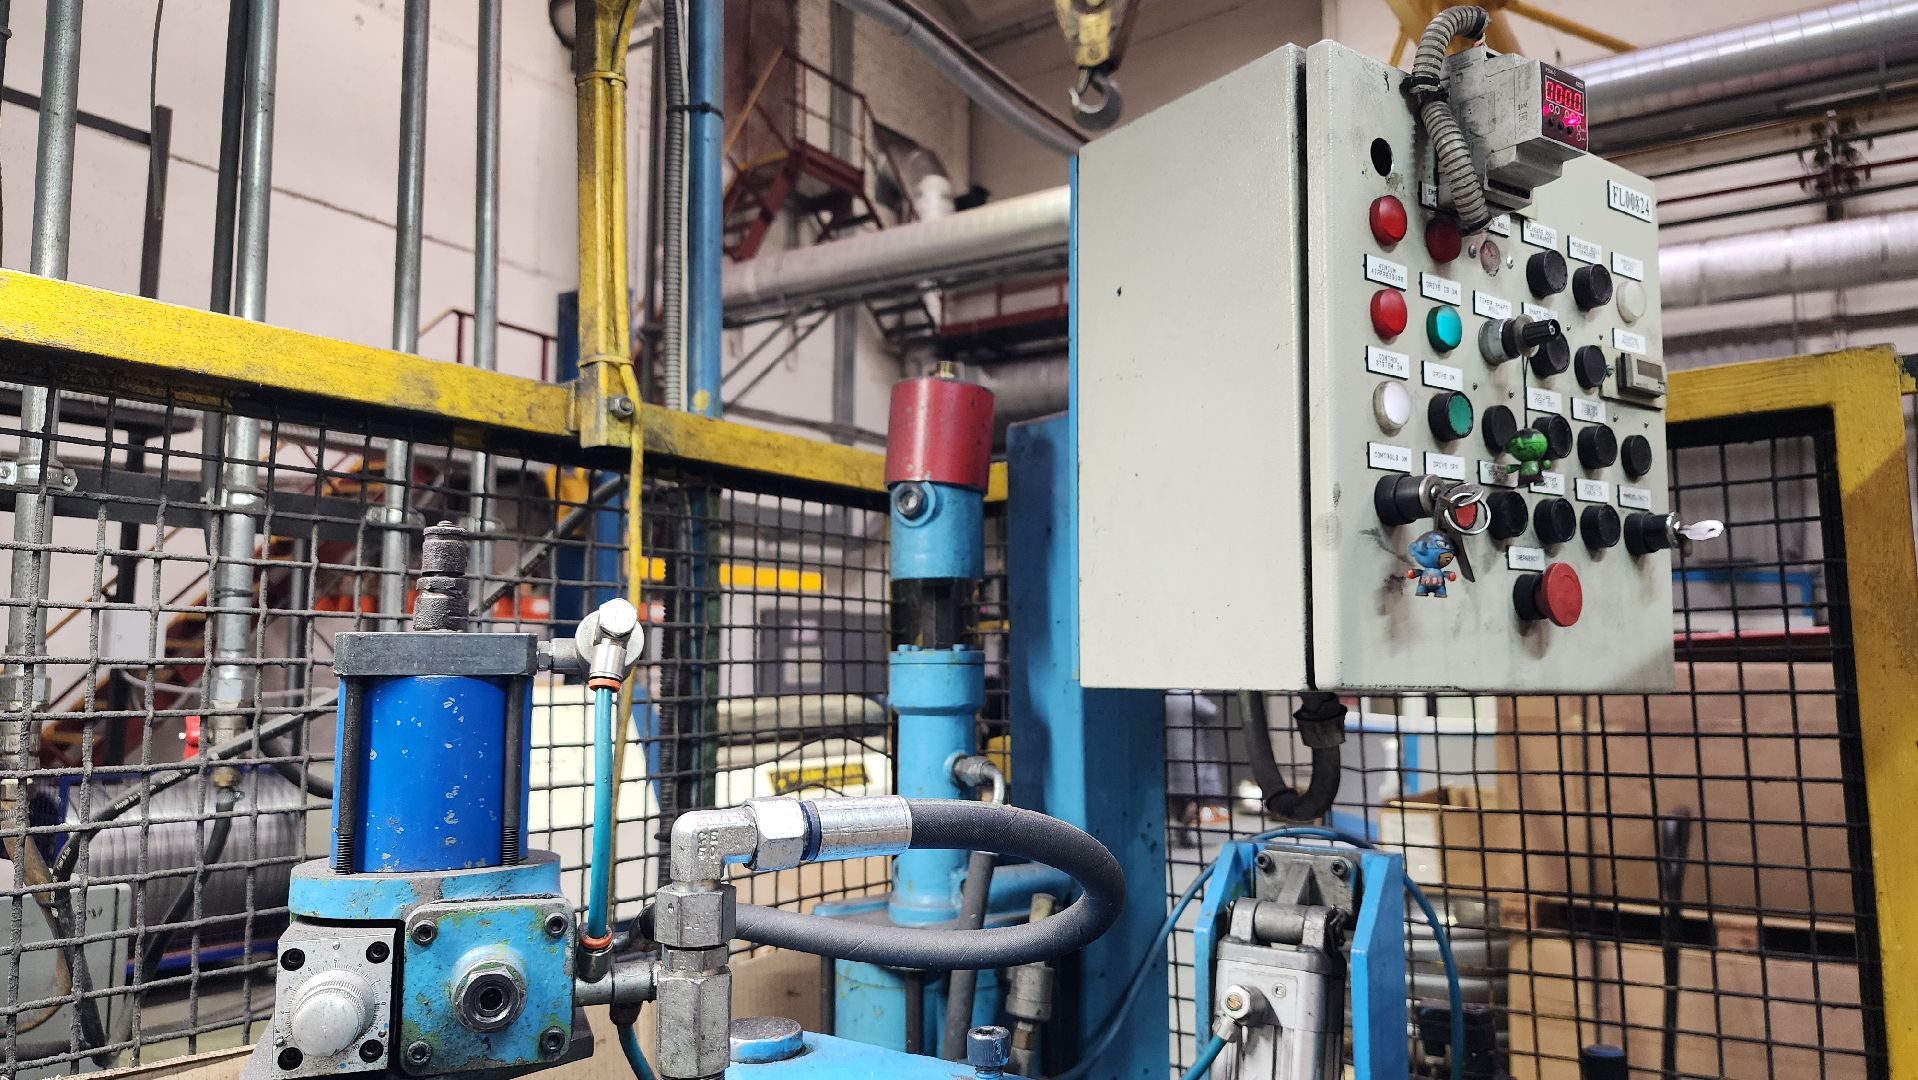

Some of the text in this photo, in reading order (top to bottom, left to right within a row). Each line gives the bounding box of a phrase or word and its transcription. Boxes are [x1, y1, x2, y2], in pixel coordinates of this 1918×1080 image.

[1546, 81, 1582, 112] 0000
[1425, 280, 1441, 291] DRIVE
[1374, 451, 1399, 462] CONTROLS
